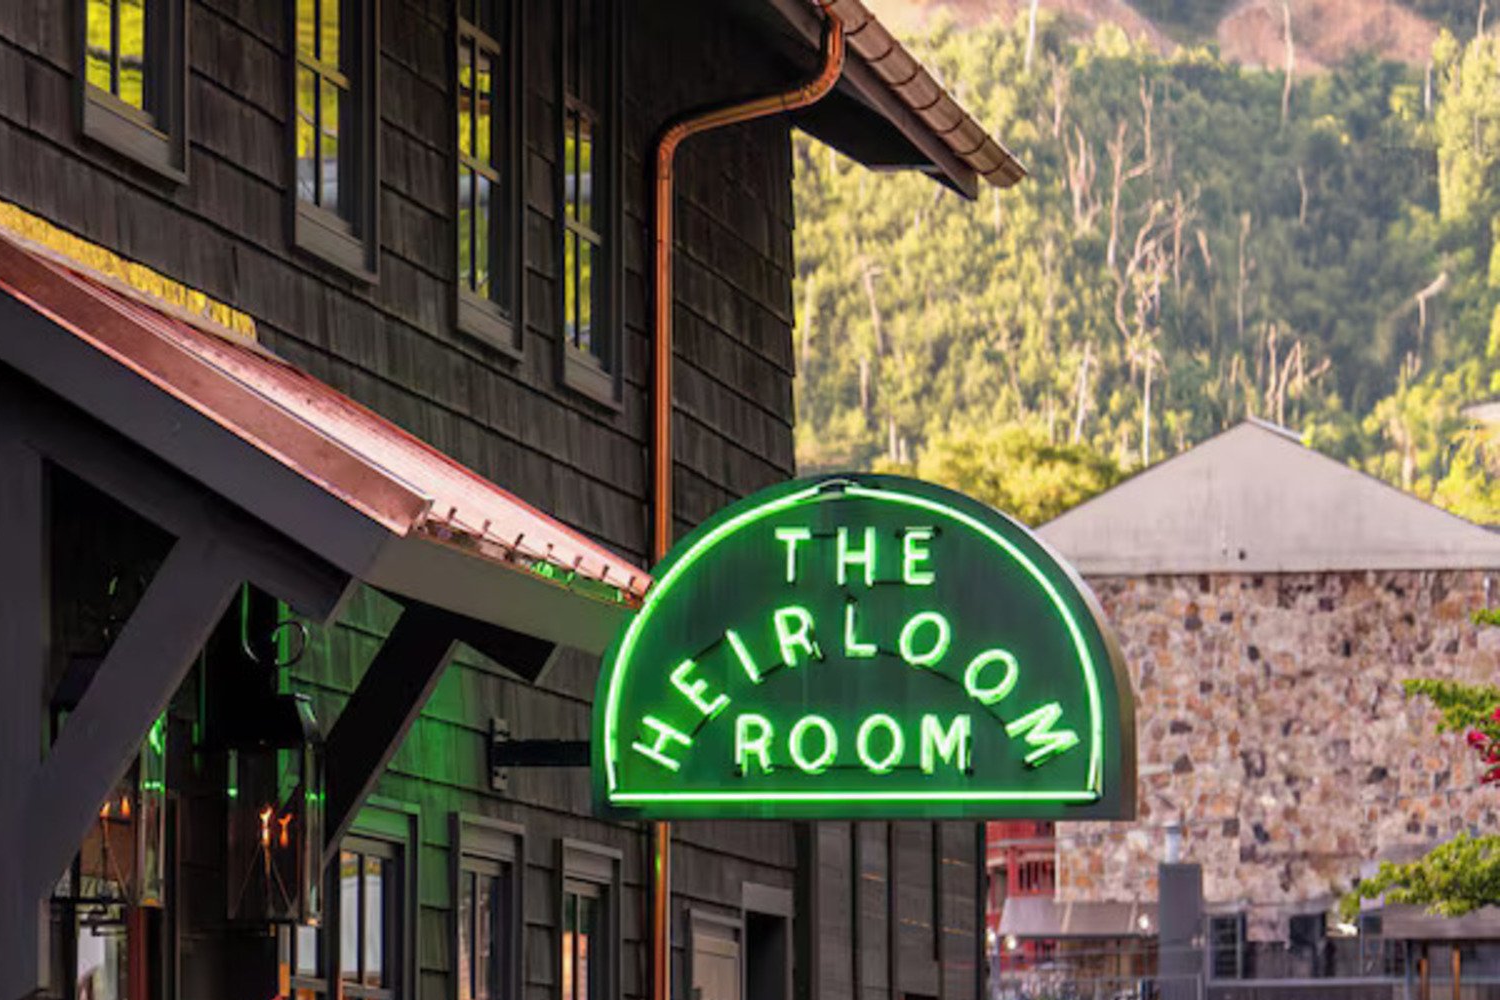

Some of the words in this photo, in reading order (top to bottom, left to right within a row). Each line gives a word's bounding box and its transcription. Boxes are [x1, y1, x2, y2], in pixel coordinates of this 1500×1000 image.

[774, 526, 935, 586] THE
[631, 602, 1080, 772] HEIRLOOM
[734, 713, 972, 775] ROOM
